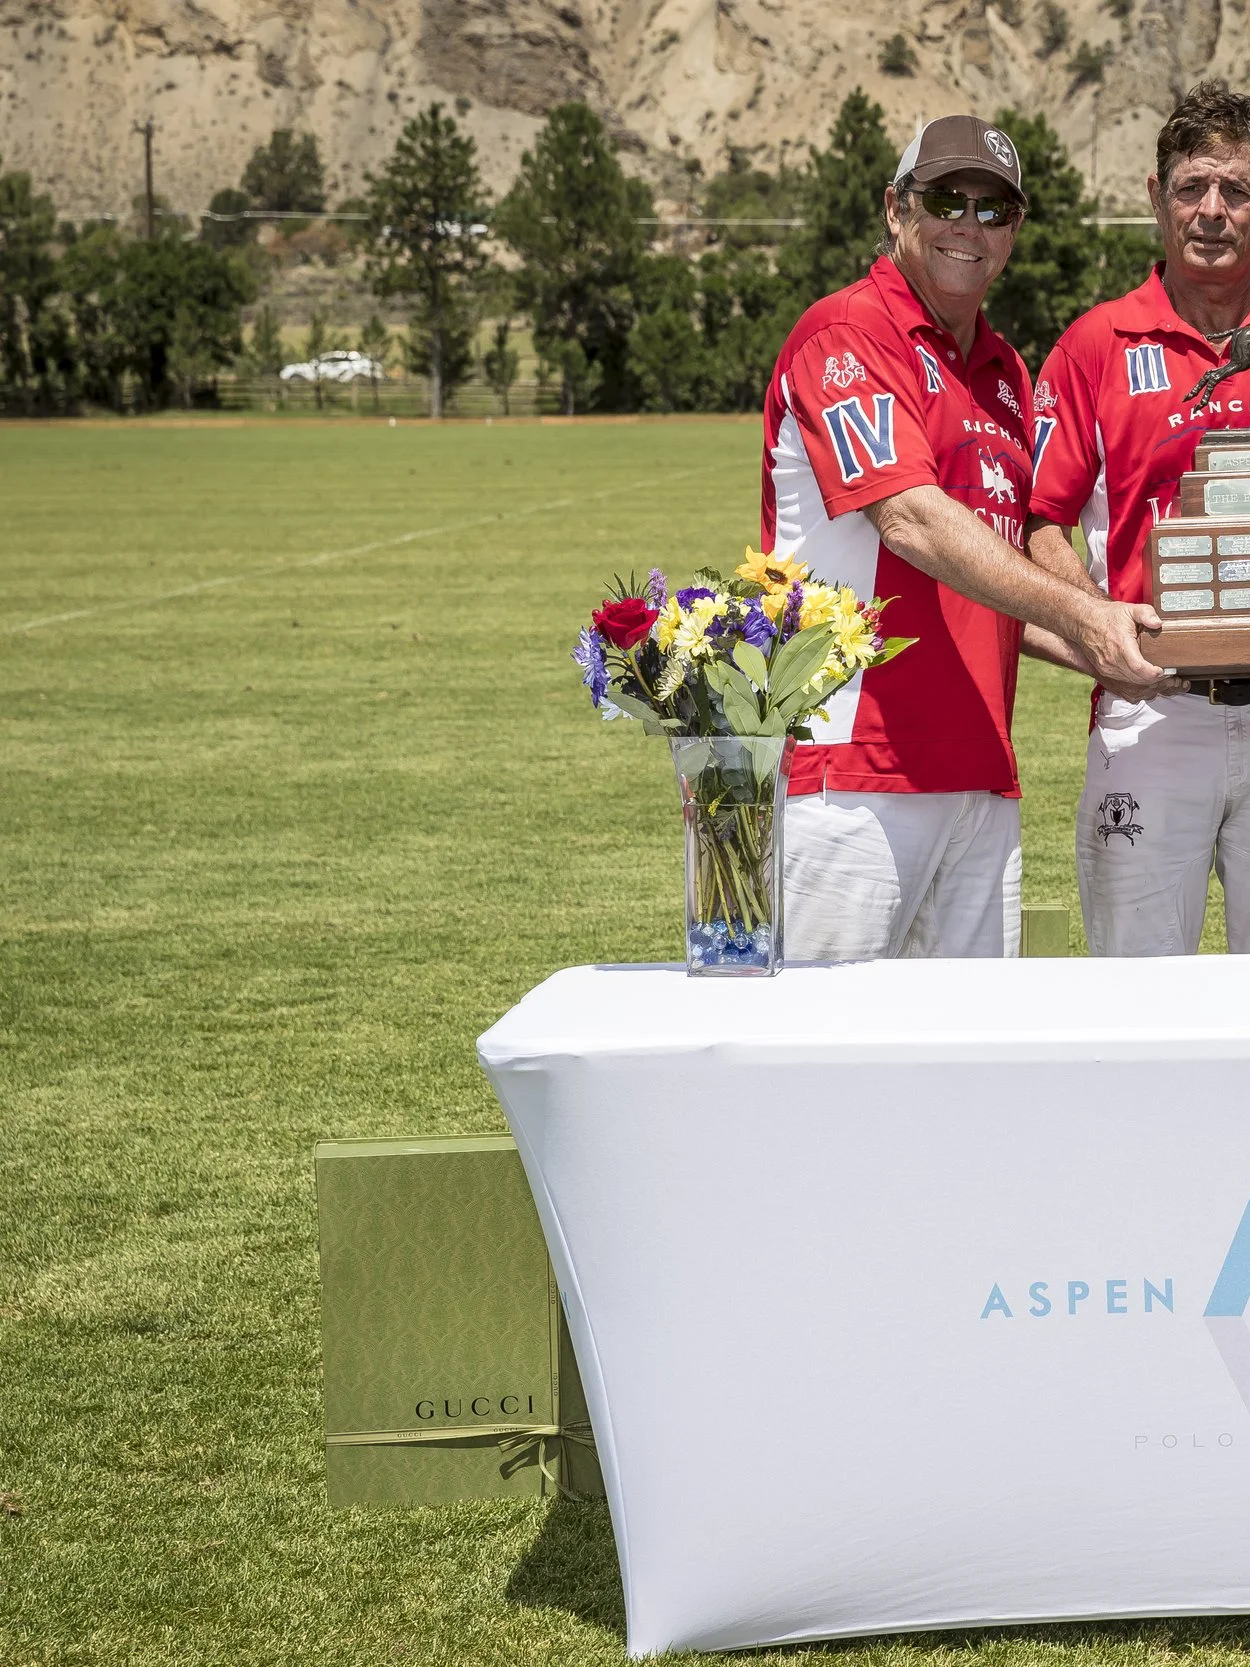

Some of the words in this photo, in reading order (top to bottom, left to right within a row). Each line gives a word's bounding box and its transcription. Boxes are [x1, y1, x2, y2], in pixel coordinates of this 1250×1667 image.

[1125, 344, 1171, 396] III
[1213, 494, 1239, 504] THE
[979, 1277, 1174, 1320] ASPEN
[415, 1395, 534, 1420] GUCCI
[1134, 1432, 1235, 1450] POLO
